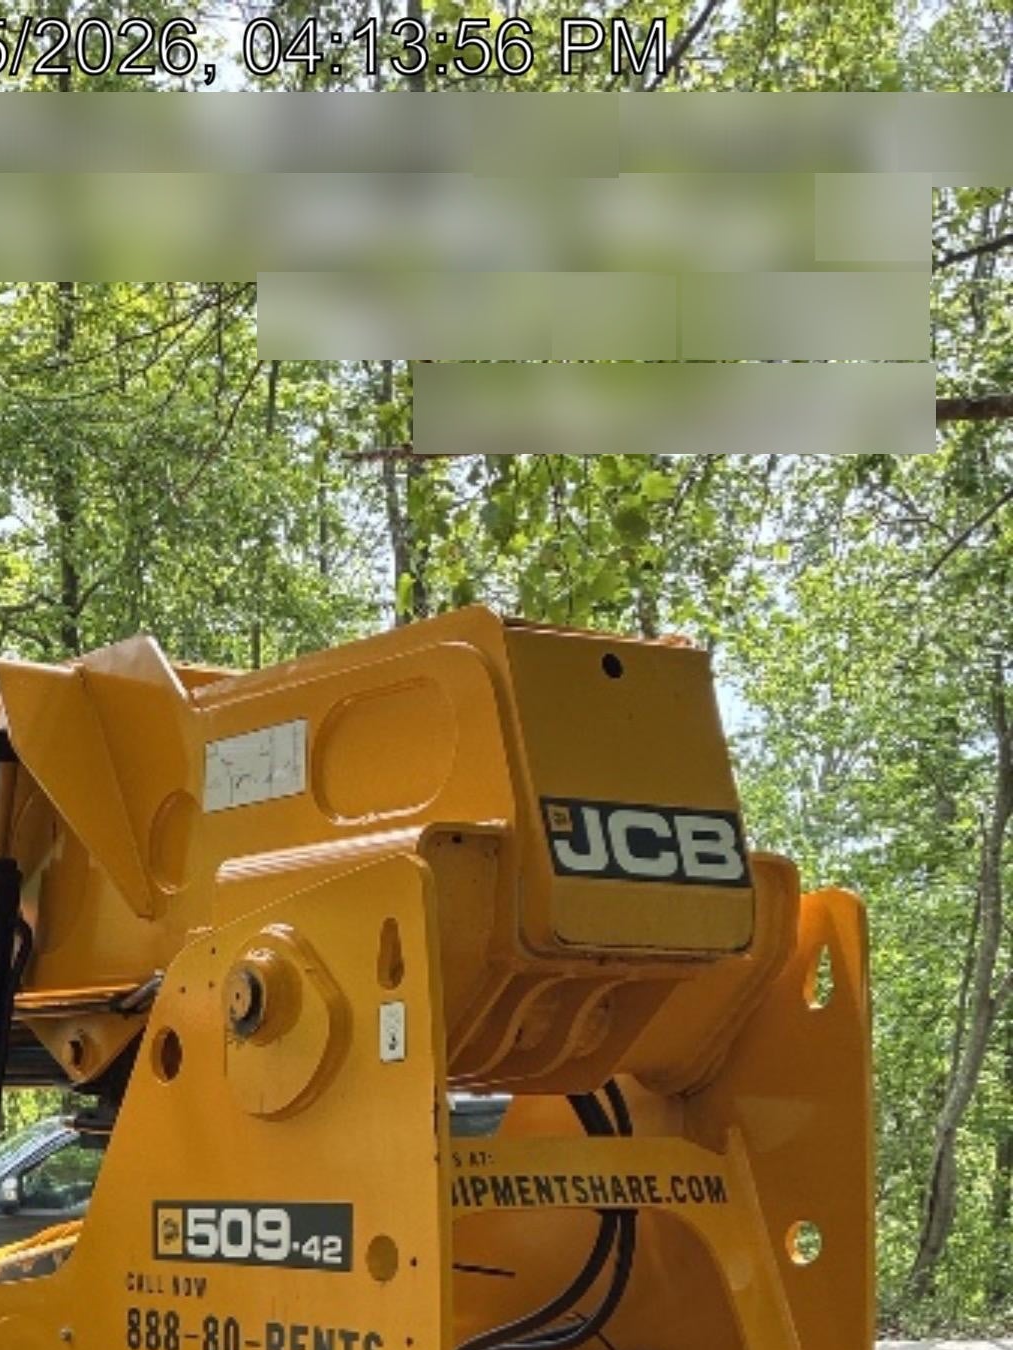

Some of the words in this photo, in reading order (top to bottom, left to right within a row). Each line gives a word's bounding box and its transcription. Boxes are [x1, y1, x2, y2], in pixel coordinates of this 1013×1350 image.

[553, 806, 745, 880] JCB
[126, 1271, 164, 1295] CALL
[172, 1274, 207, 1299] NOW
